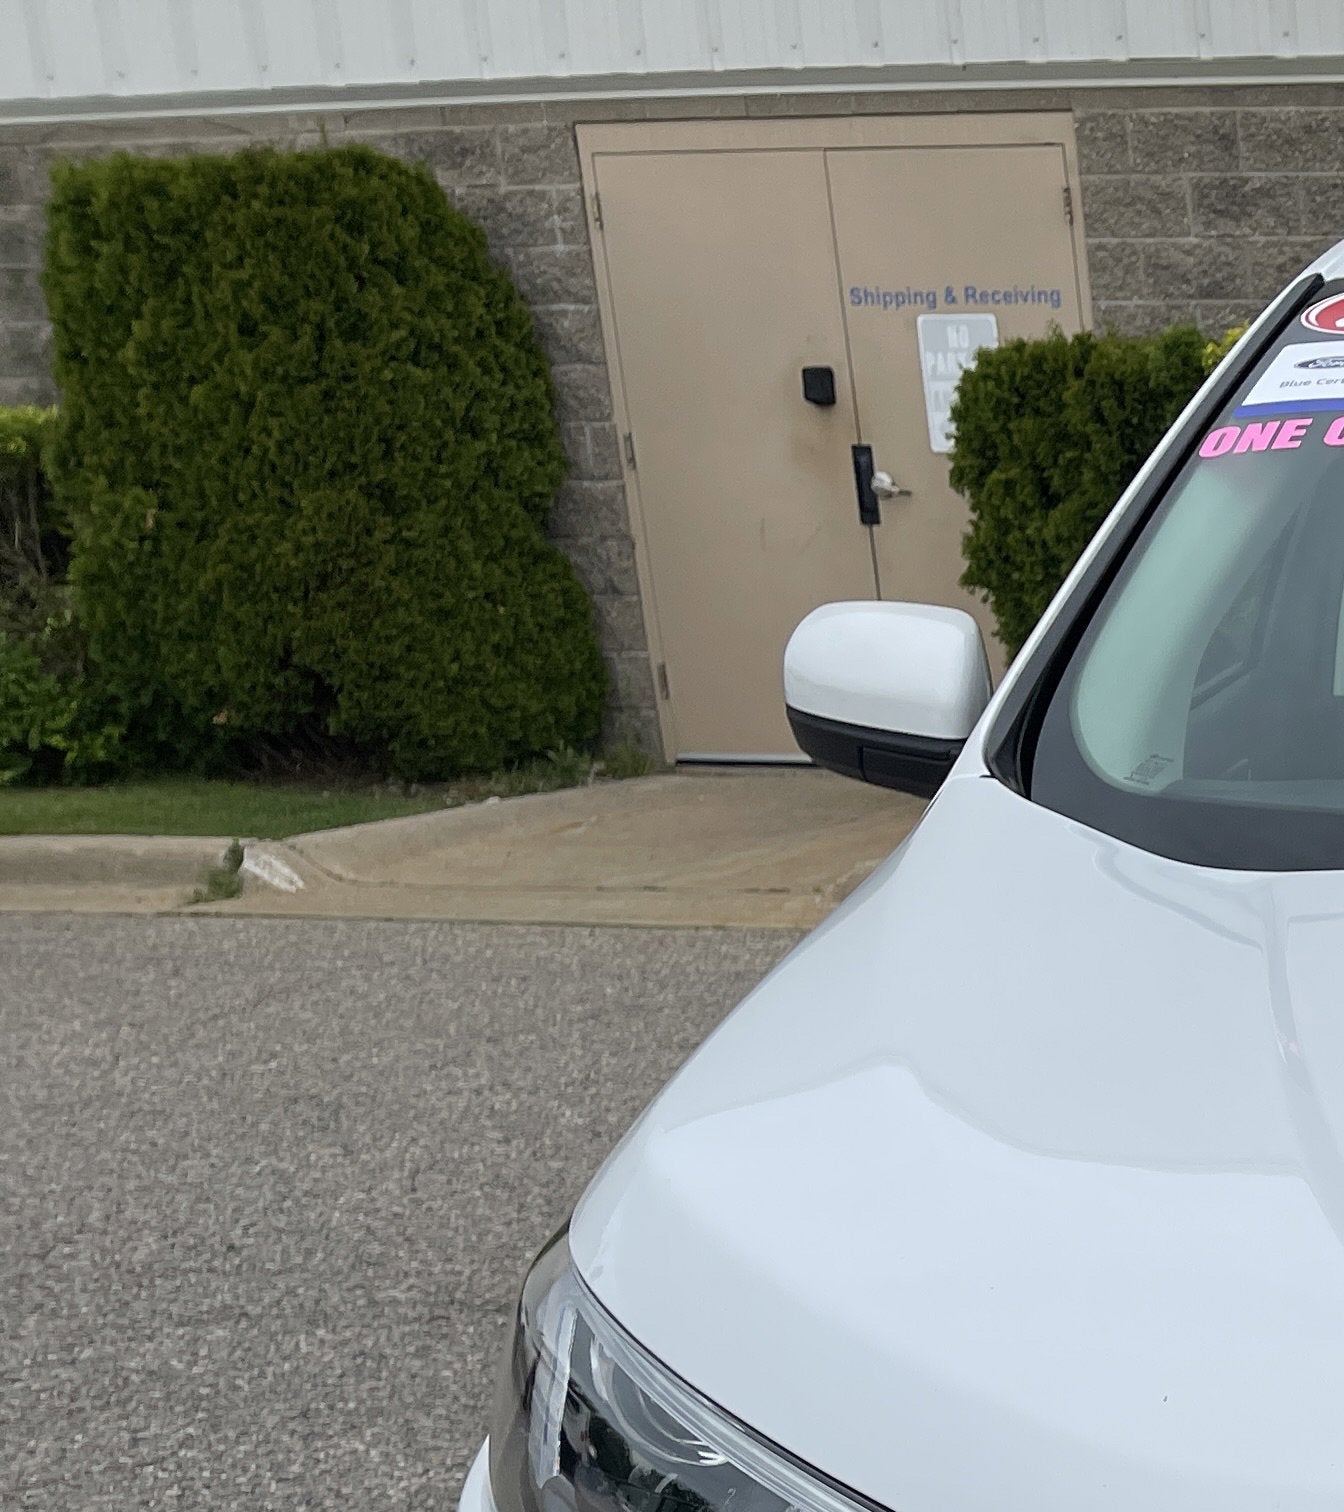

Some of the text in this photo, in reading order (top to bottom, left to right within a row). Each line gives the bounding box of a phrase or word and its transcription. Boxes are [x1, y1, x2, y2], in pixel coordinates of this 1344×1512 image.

[849, 285, 1062, 310] Shipping & Receiving
[1198, 417, 1313, 459] ONE
